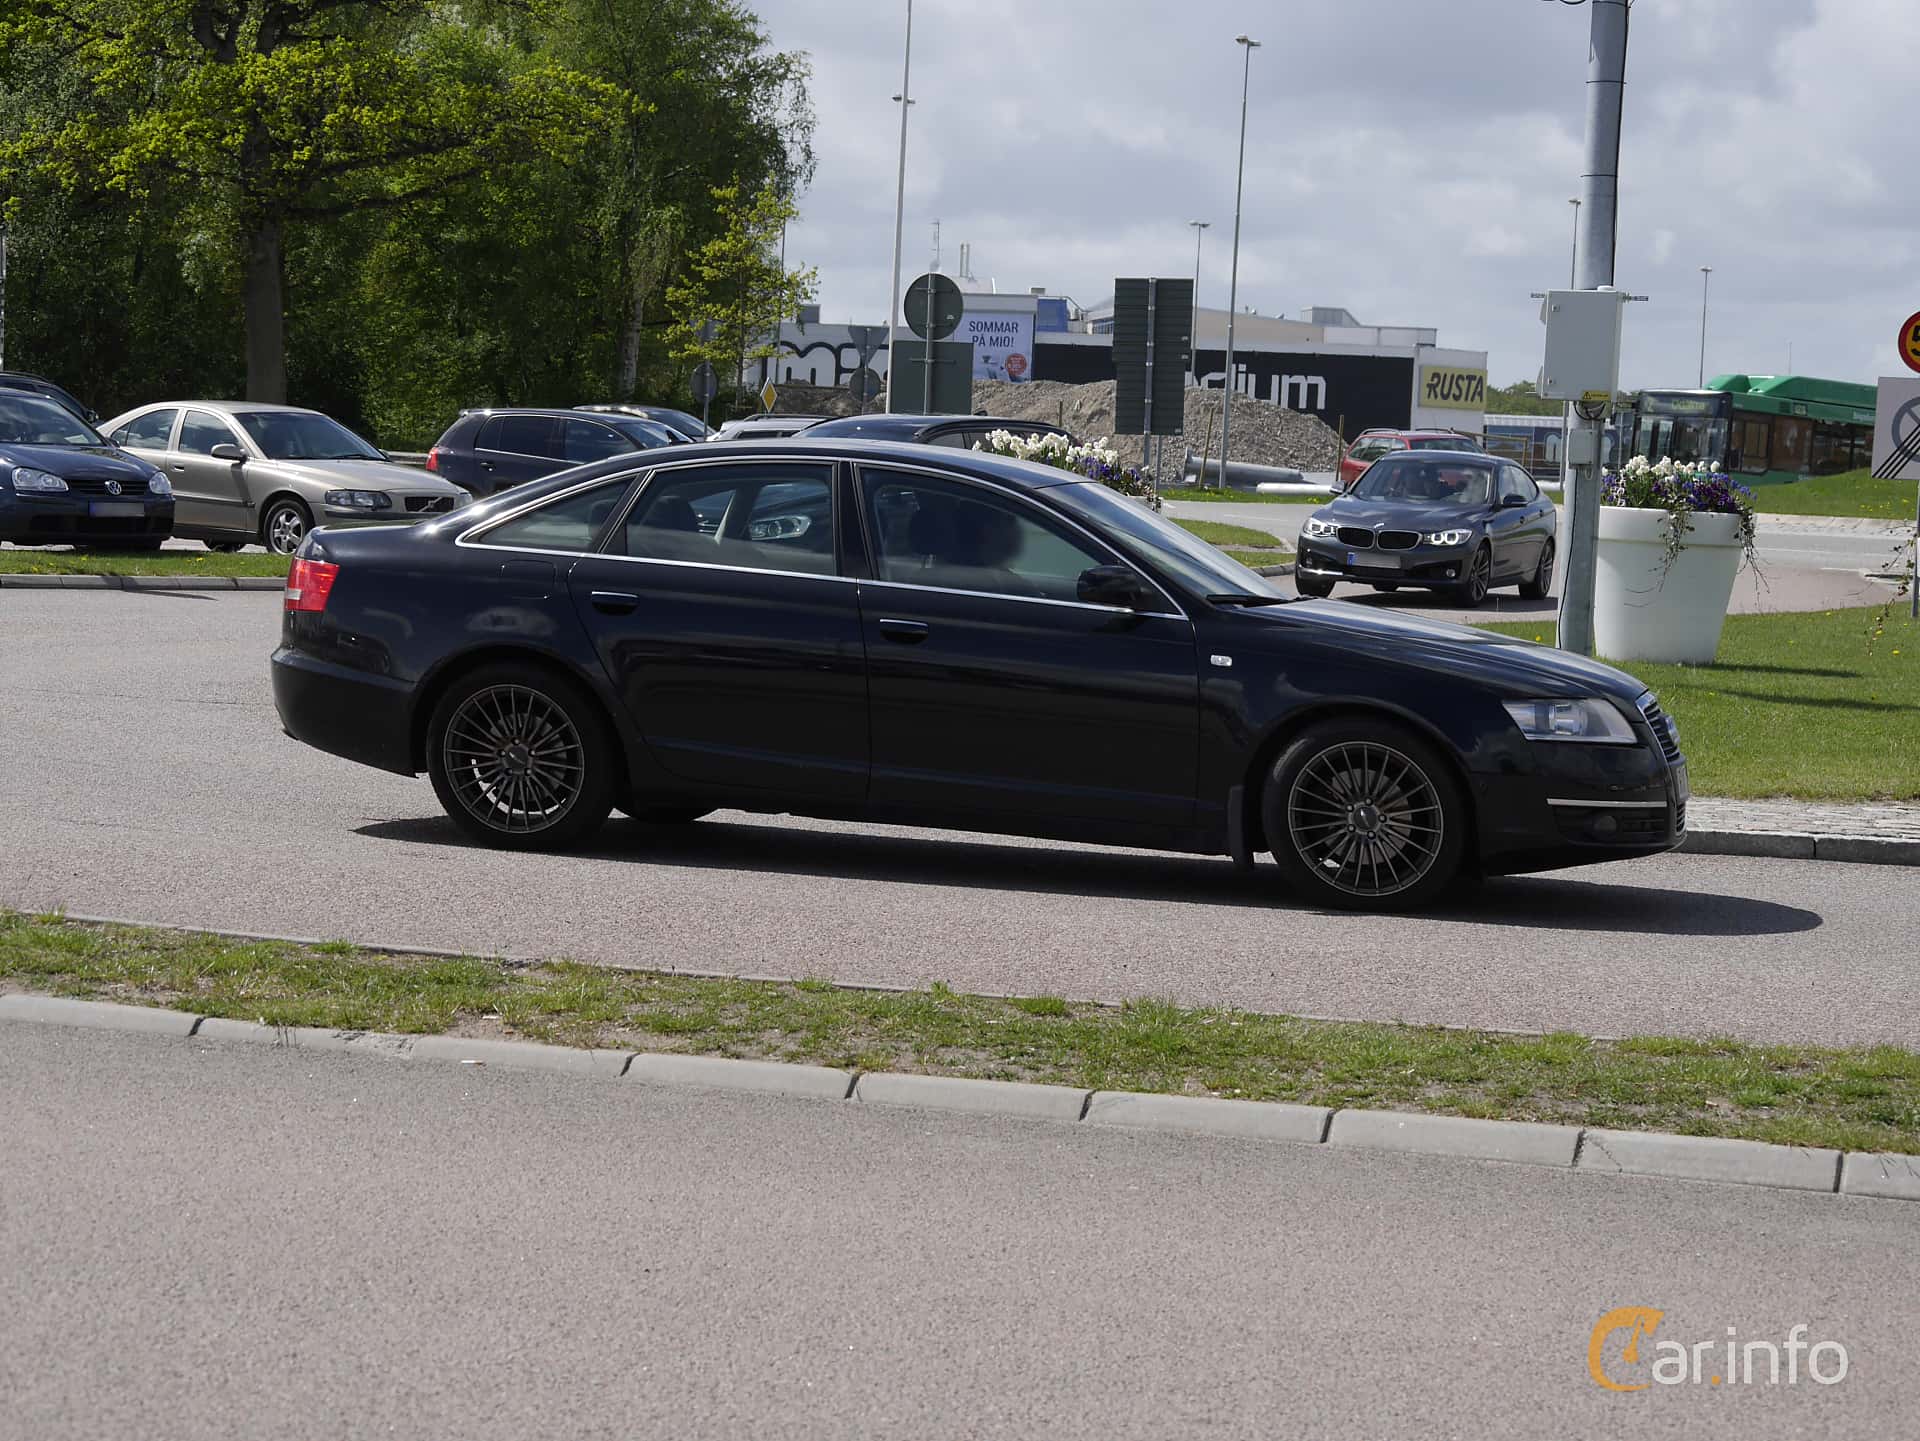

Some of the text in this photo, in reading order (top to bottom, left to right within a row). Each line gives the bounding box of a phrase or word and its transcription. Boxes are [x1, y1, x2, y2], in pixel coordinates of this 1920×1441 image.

[969, 321, 1018, 333] SOMMAR
[972, 334, 1015, 347] PÅ MIO!
[1426, 372, 1484, 402] RUSTA
